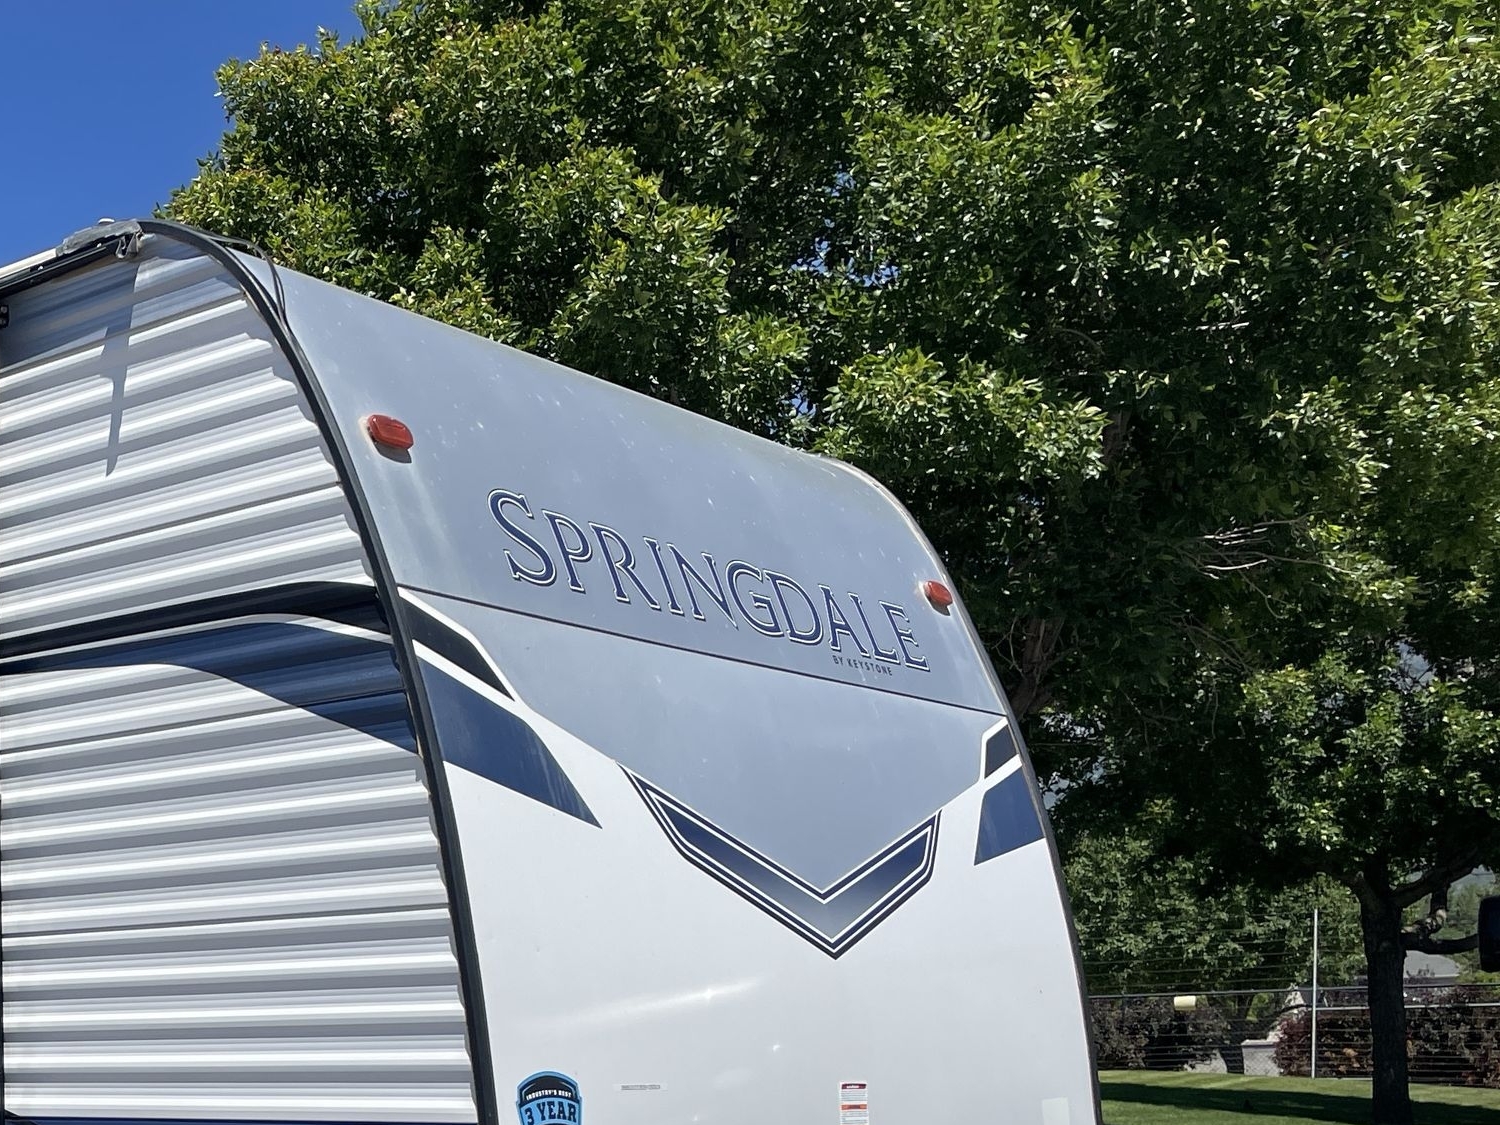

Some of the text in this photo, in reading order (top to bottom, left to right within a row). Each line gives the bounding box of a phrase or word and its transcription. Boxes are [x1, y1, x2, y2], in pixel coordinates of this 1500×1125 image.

[487, 488, 931, 672] SPRINGDALE
[832, 655, 893, 676] BY KEYSTONE
[558, 1089, 572, 1099] BEST
[536, 1101, 577, 1123] YEAR
